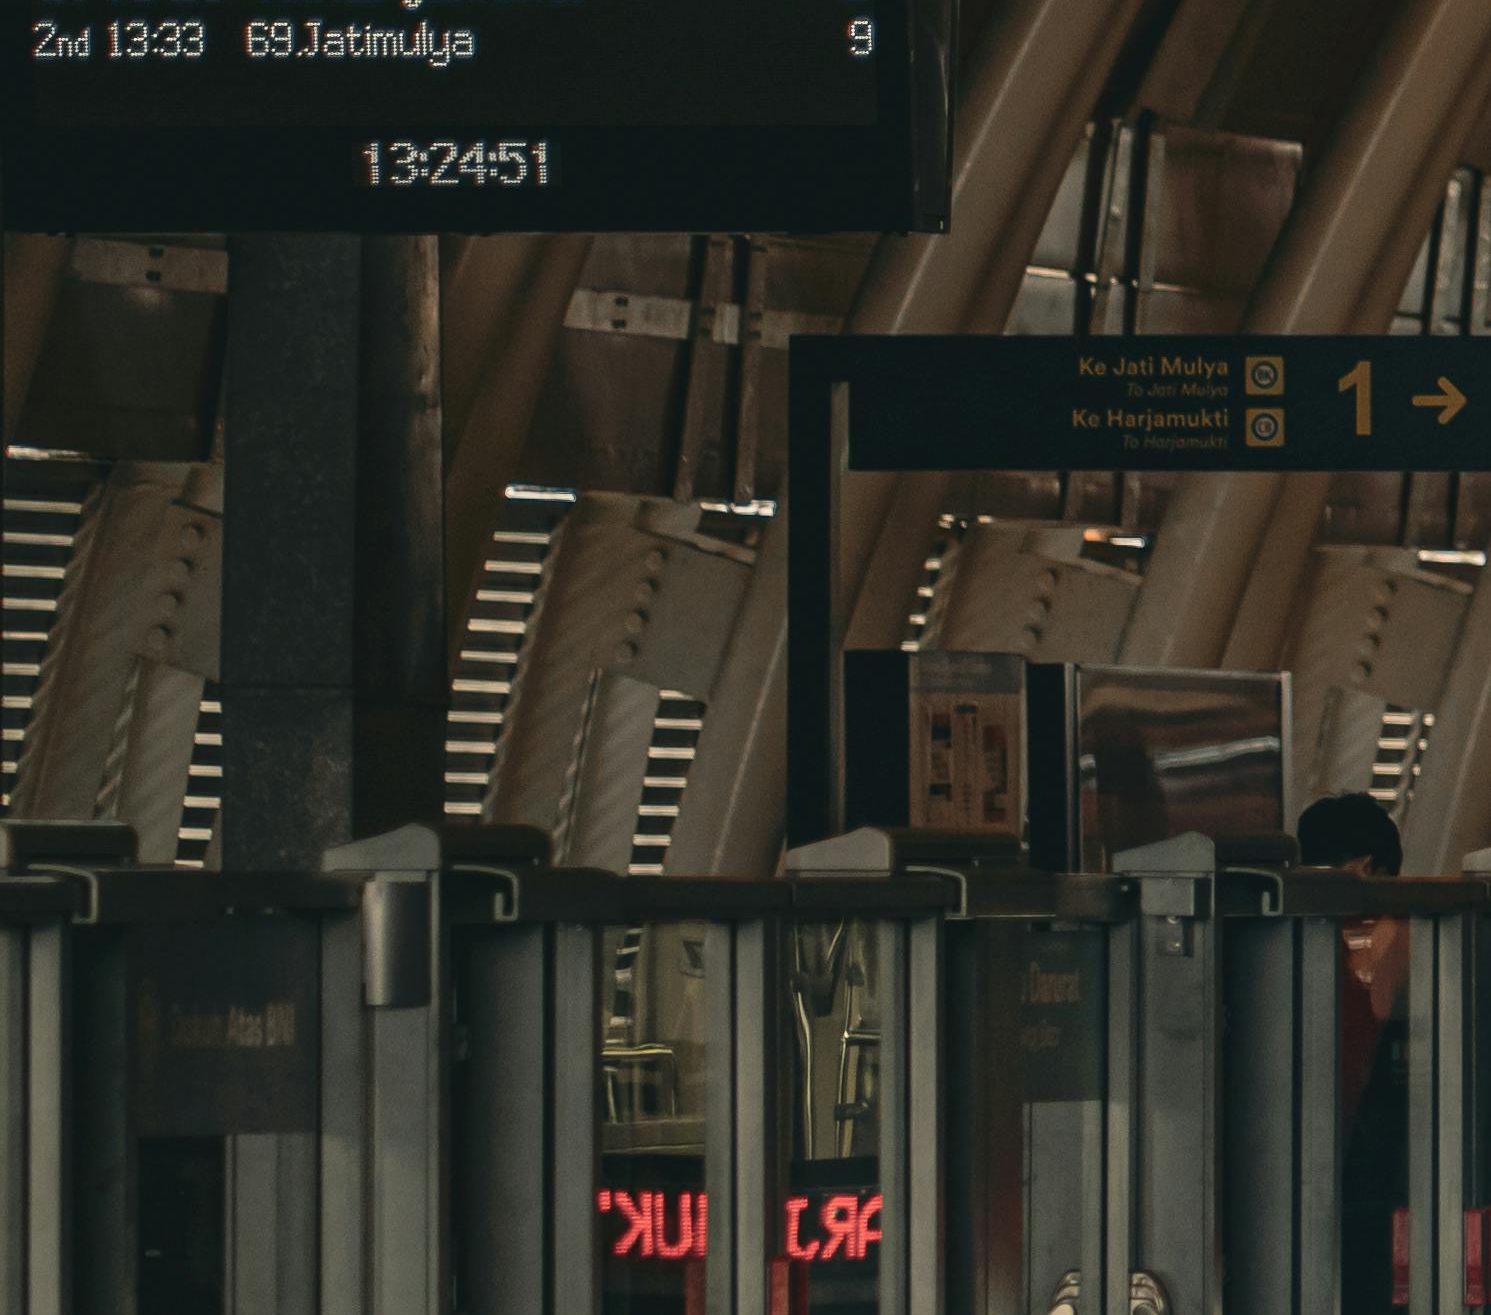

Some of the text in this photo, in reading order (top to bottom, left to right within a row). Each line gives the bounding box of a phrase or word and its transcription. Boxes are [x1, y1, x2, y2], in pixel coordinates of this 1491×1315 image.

[34, 22, 91, 59] 2nd
[109, 22, 206, 59] 13:33
[847, 20, 875, 57] 9
[362, 141, 549, 186] 13:24:51
[1079, 356, 1230, 379] Ke Jati Mulya
[1338, 361, 1372, 436] 1
[1071, 408, 1230, 432] Ke Harjamukti
